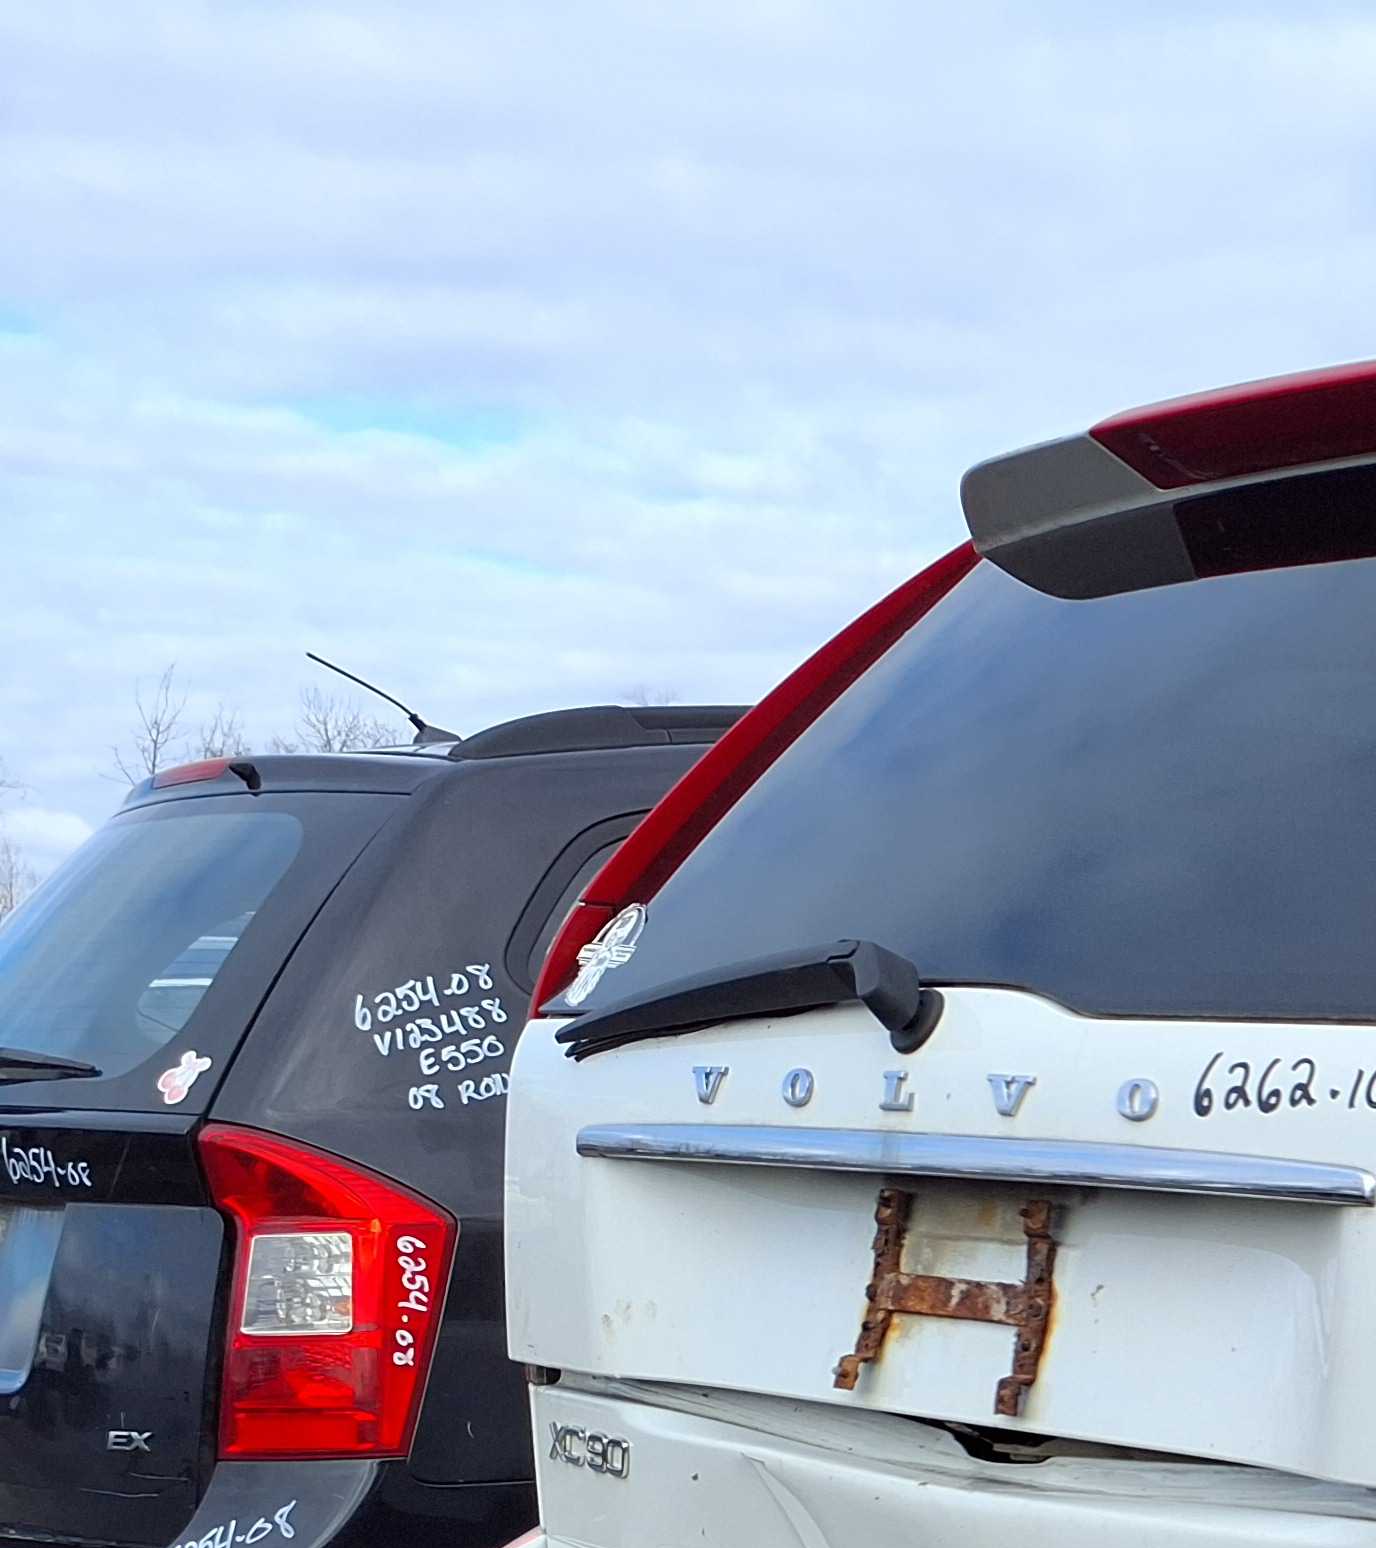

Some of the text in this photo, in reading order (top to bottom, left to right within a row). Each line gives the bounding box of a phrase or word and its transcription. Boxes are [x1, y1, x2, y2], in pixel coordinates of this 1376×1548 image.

[373, 997, 508, 1056] V123488
[419, 1034, 505, 1075] E550
[408, 1084, 445, 1110] 08
[692, 1065, 1160, 1122] VOLVO
[107, 1430, 153, 1452] EX
[548, 1420, 630, 1480] XC90
